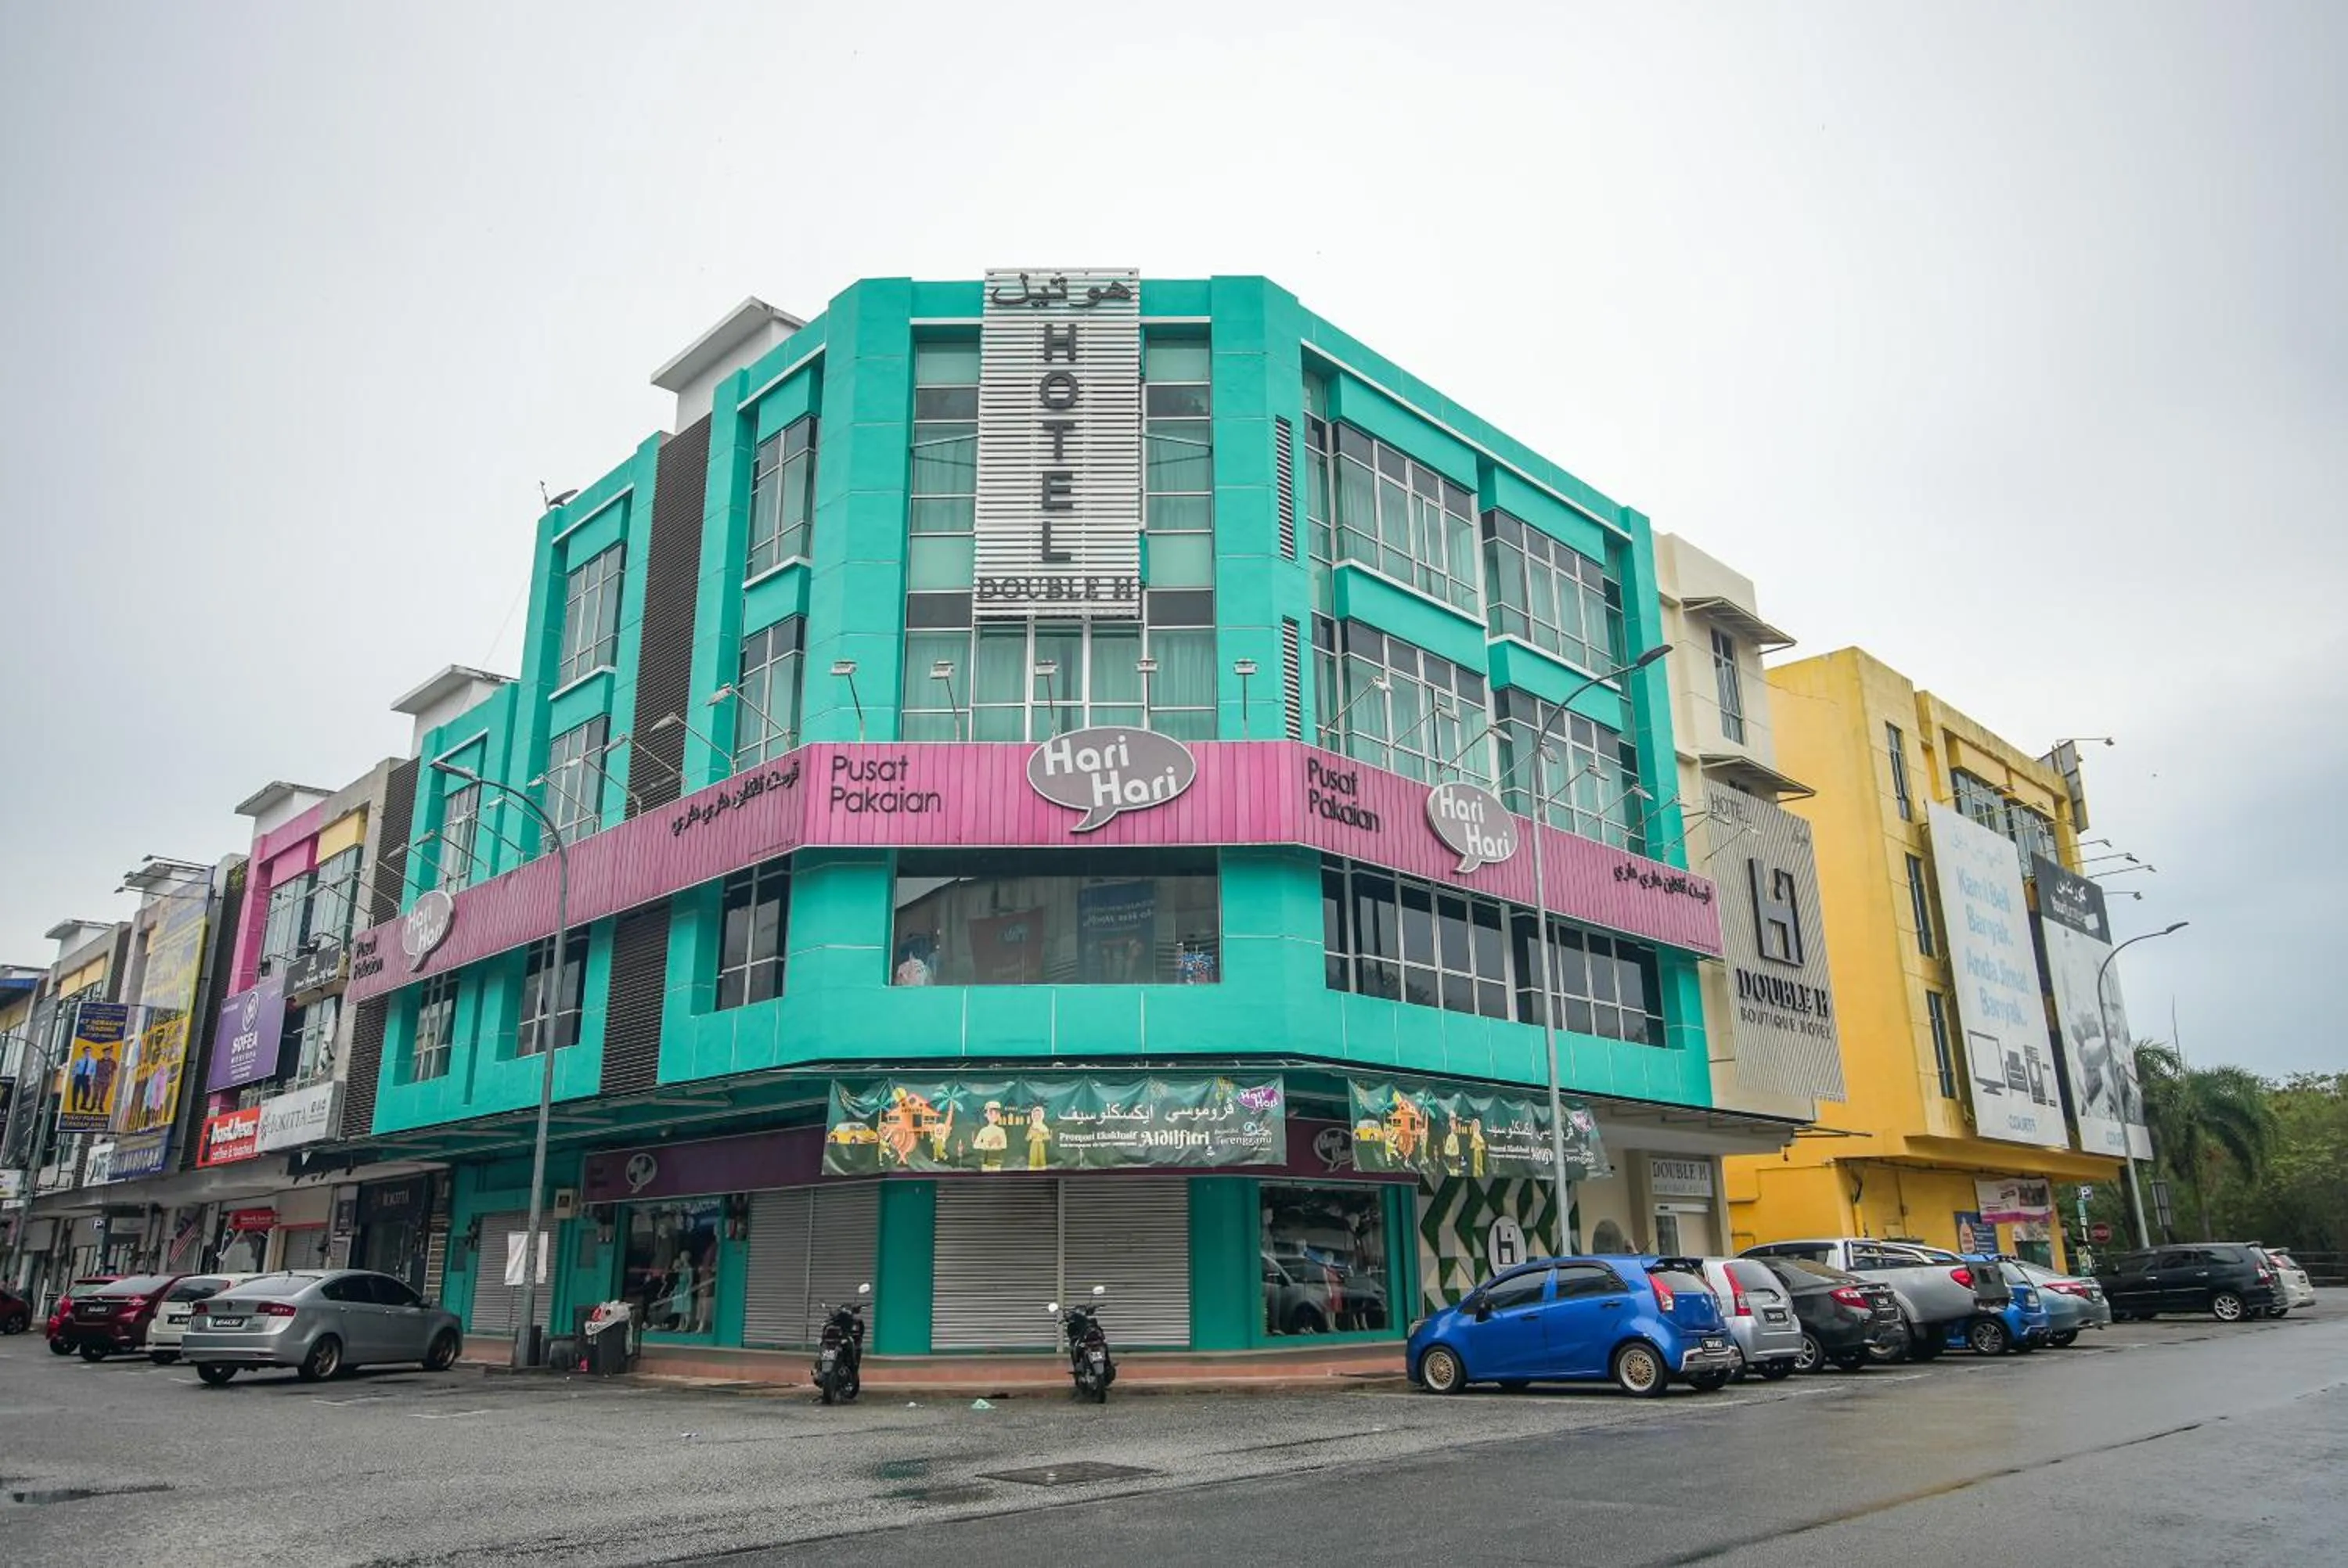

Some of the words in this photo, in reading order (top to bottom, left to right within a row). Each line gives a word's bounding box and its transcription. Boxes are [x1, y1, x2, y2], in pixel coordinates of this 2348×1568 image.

[1039, 323, 1079, 563] HOTEL
[977, 576, 1098, 599] DOUBLE
[1113, 577, 1135, 599] H
[832, 756, 909, 781] Pusat
[1043, 735, 1129, 775] Hari
[1093, 766, 1176, 807] Hari
[1308, 758, 1359, 793] Pusat
[830, 786, 941, 813] Pakaian
[1309, 789, 1380, 833] Pakaian
[1439, 791, 1484, 825] Hari
[1466, 823, 1510, 858] Hari
[407, 904, 431, 934] Hari
[417, 915, 445, 951] Hari
[1736, 968, 1812, 1014] DOUBLE
